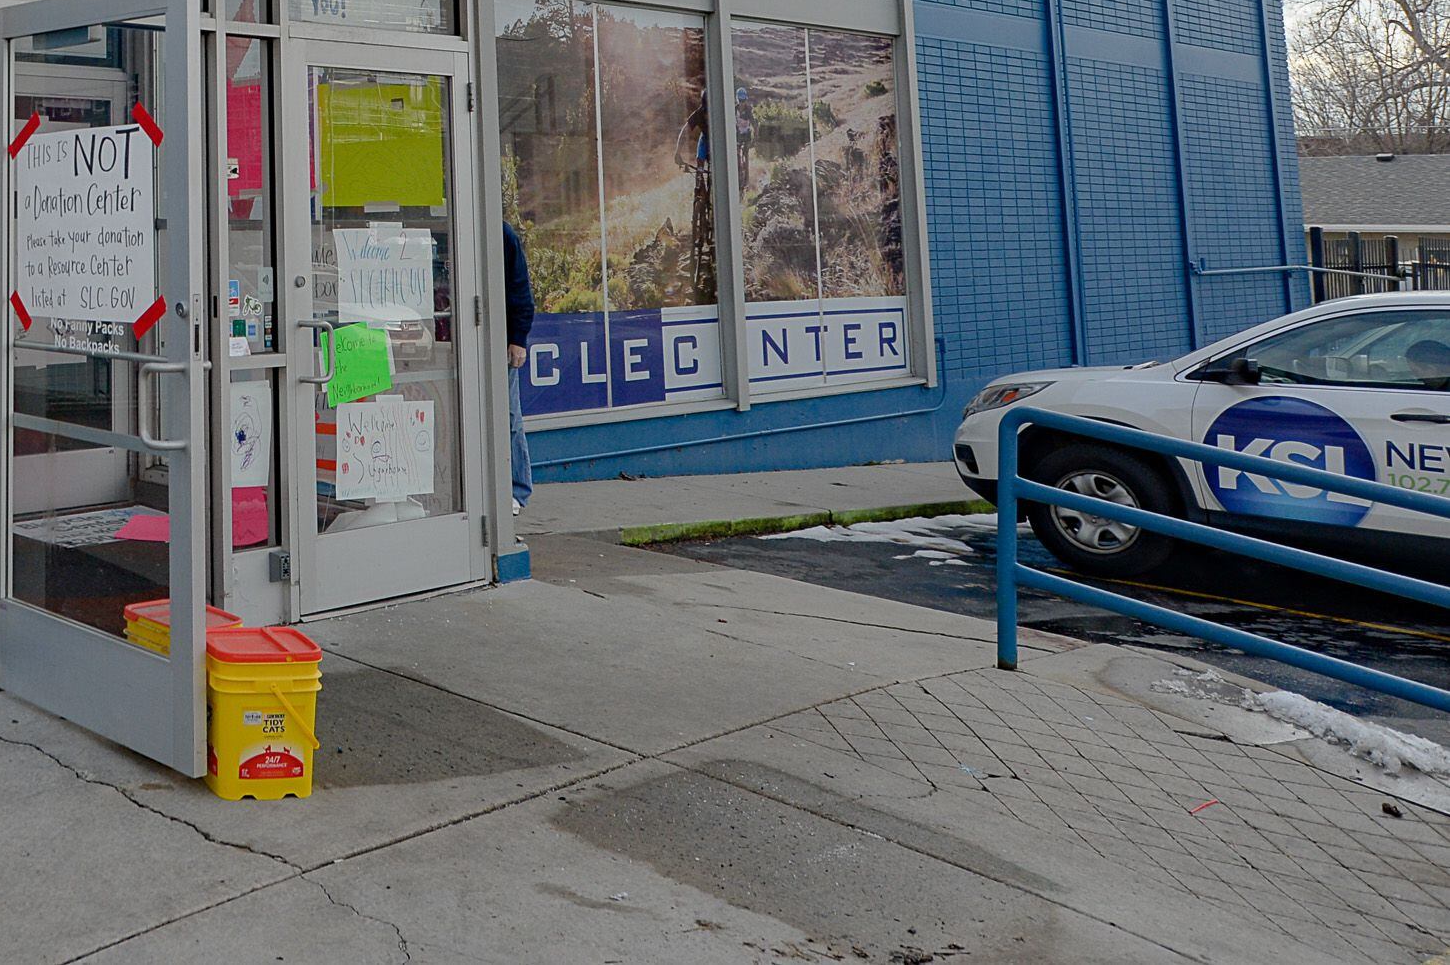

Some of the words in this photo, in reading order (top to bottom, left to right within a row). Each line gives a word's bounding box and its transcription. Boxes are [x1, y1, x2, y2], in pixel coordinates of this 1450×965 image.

[25, 142, 51, 169] THIS
[56, 140, 68, 163] IS
[73, 127, 140, 179] NOT
[24, 195, 31, 209] a
[33, 185, 83, 220] Donation
[86, 183, 142, 217] Center
[27, 233, 47, 251] Please
[49, 233, 66, 248] take
[68, 230, 92, 253] your
[97, 226, 144, 248] donation
[400, 231, 412, 260] 2
[25, 261, 35, 278] to
[37, 263, 44, 276] a
[48, 255, 86, 278] Resource
[89, 254, 133, 277] Center
[31, 287, 53, 308] listed
[57, 288, 67, 306] at
[50, 317, 63, 329] No
[95, 320, 124, 336] Packs
[54, 335, 67, 348] No
[70, 336, 120, 355] Backpacks
[1217, 434, 1373, 507] KSL
[265, 756, 281, 764] 24/7
